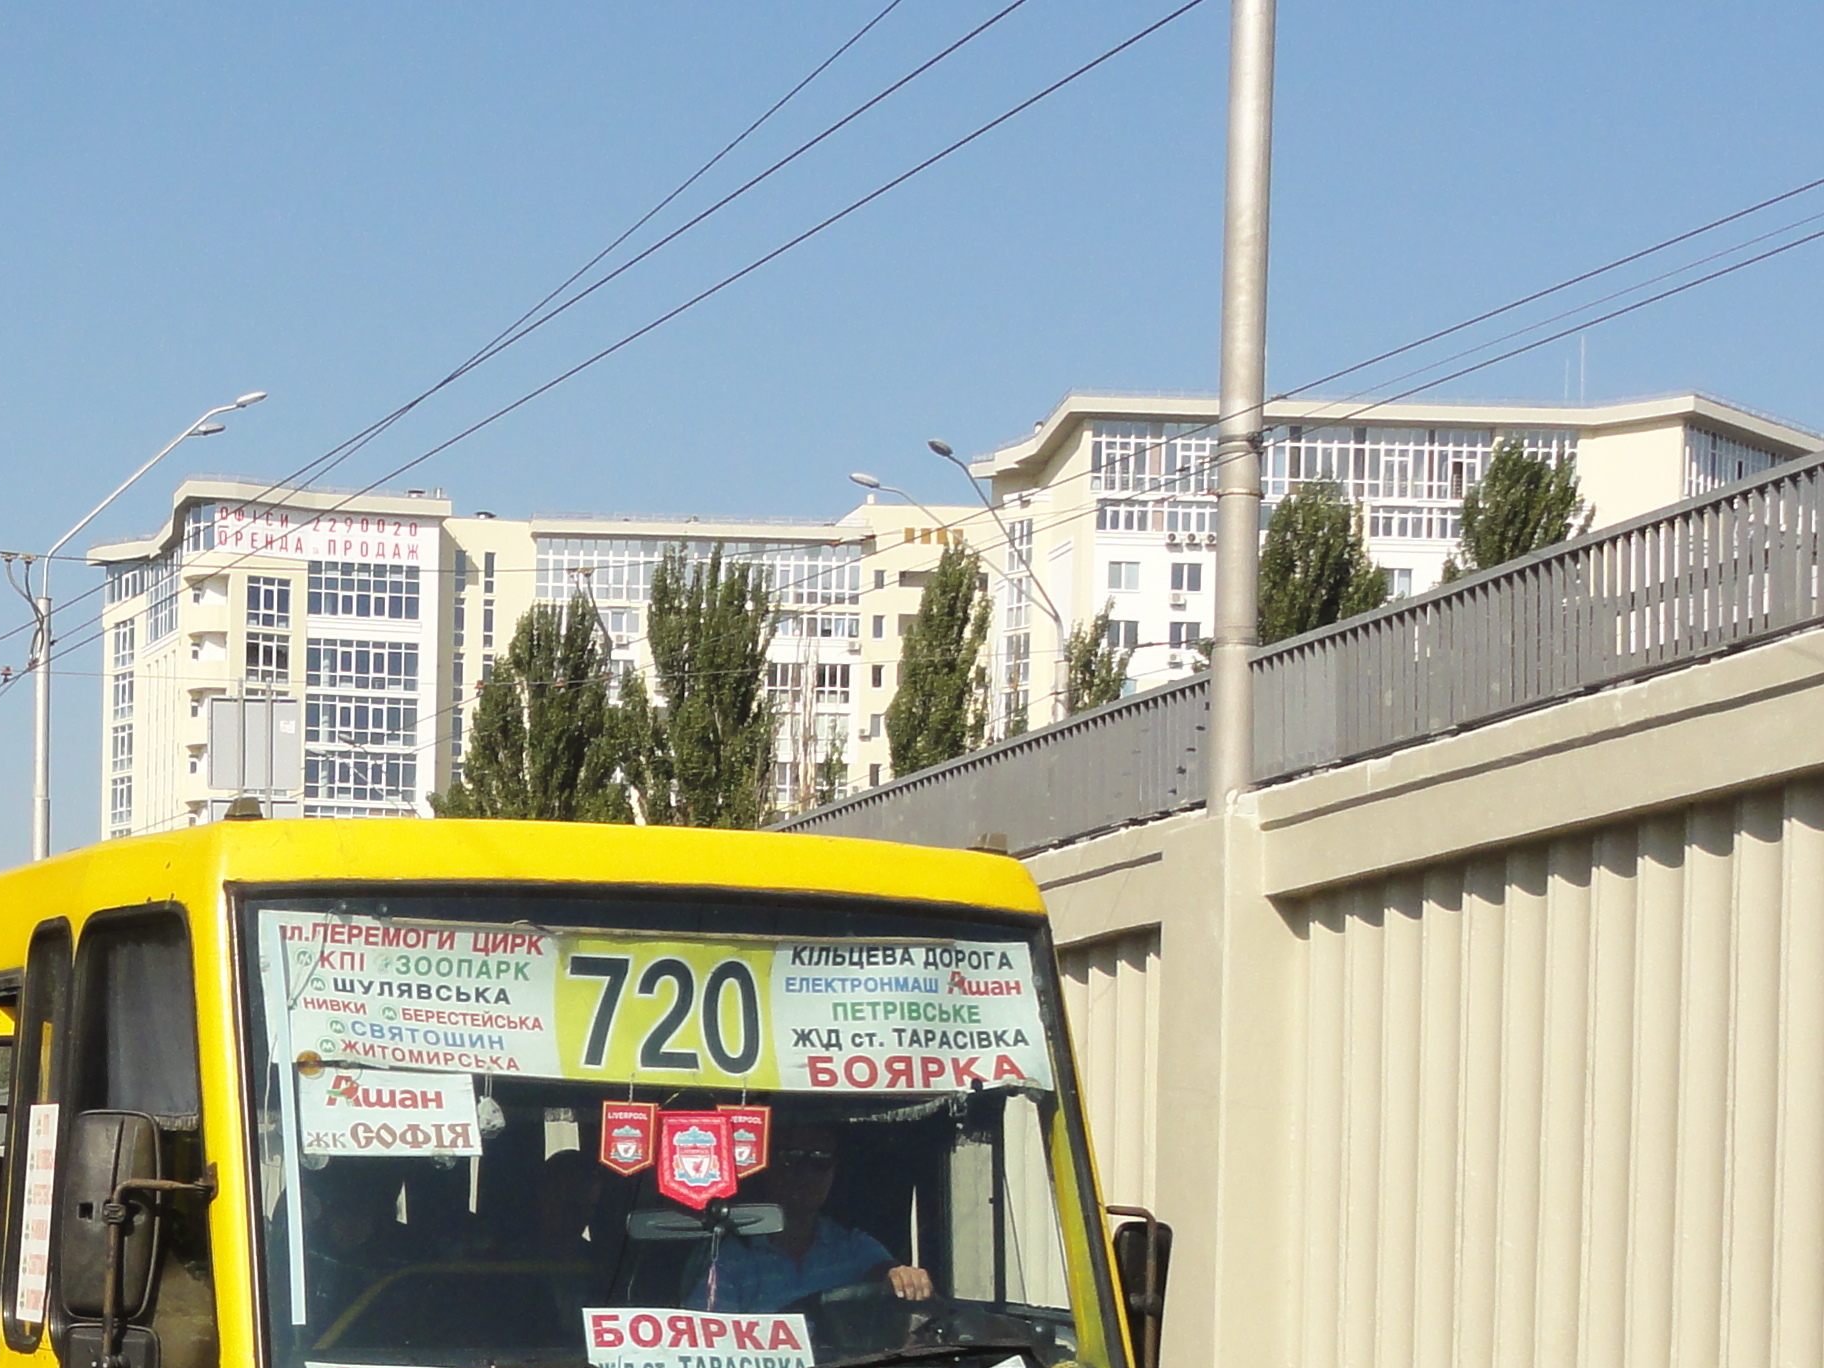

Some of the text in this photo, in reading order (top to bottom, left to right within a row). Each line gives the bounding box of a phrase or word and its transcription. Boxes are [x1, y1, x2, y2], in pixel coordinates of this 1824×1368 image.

[220, 506, 289, 528] ОФІСИ
[312, 517, 418, 537] 2290020
[219, 529, 304, 555] ОРЕНДА
[327, 538, 419, 560] ПРОДАЖ
[472, 930, 544, 956] ЦИРК
[319, 949, 366, 973] КПІ
[394, 954, 532, 982] ЗООПАРК
[790, 945, 1014, 971] КІЛЬЦЕВА ДОРОГА
[332, 977, 511, 1006] ШУЛЯВСЬКА
[784, 970, 1022, 996] ЕЛЕКТРОНМАШ Ашан
[303, 996, 368, 1016] НИВКИ
[401, 1007, 544, 1032] БЕРЕСТЕЙСЬКА
[568, 953, 761, 1073] 720
[831, 1001, 982, 1024] ПЕТРІВСЬКЕ
[350, 1020, 505, 1051] СВЯТОШИН
[850, 1032, 885, 1050] ст.
[892, 1028, 1030, 1050] ТАРАСІВКА
[339, 1038, 521, 1072] ЖИТОМИРСЬКА
[806, 1053, 1029, 1090] БОЯРКА
[325, 1074, 445, 1110] Ашан
[349, 1122, 475, 1150] СОФІЯ
[589, 1313, 803, 1351] БОЯРКА
